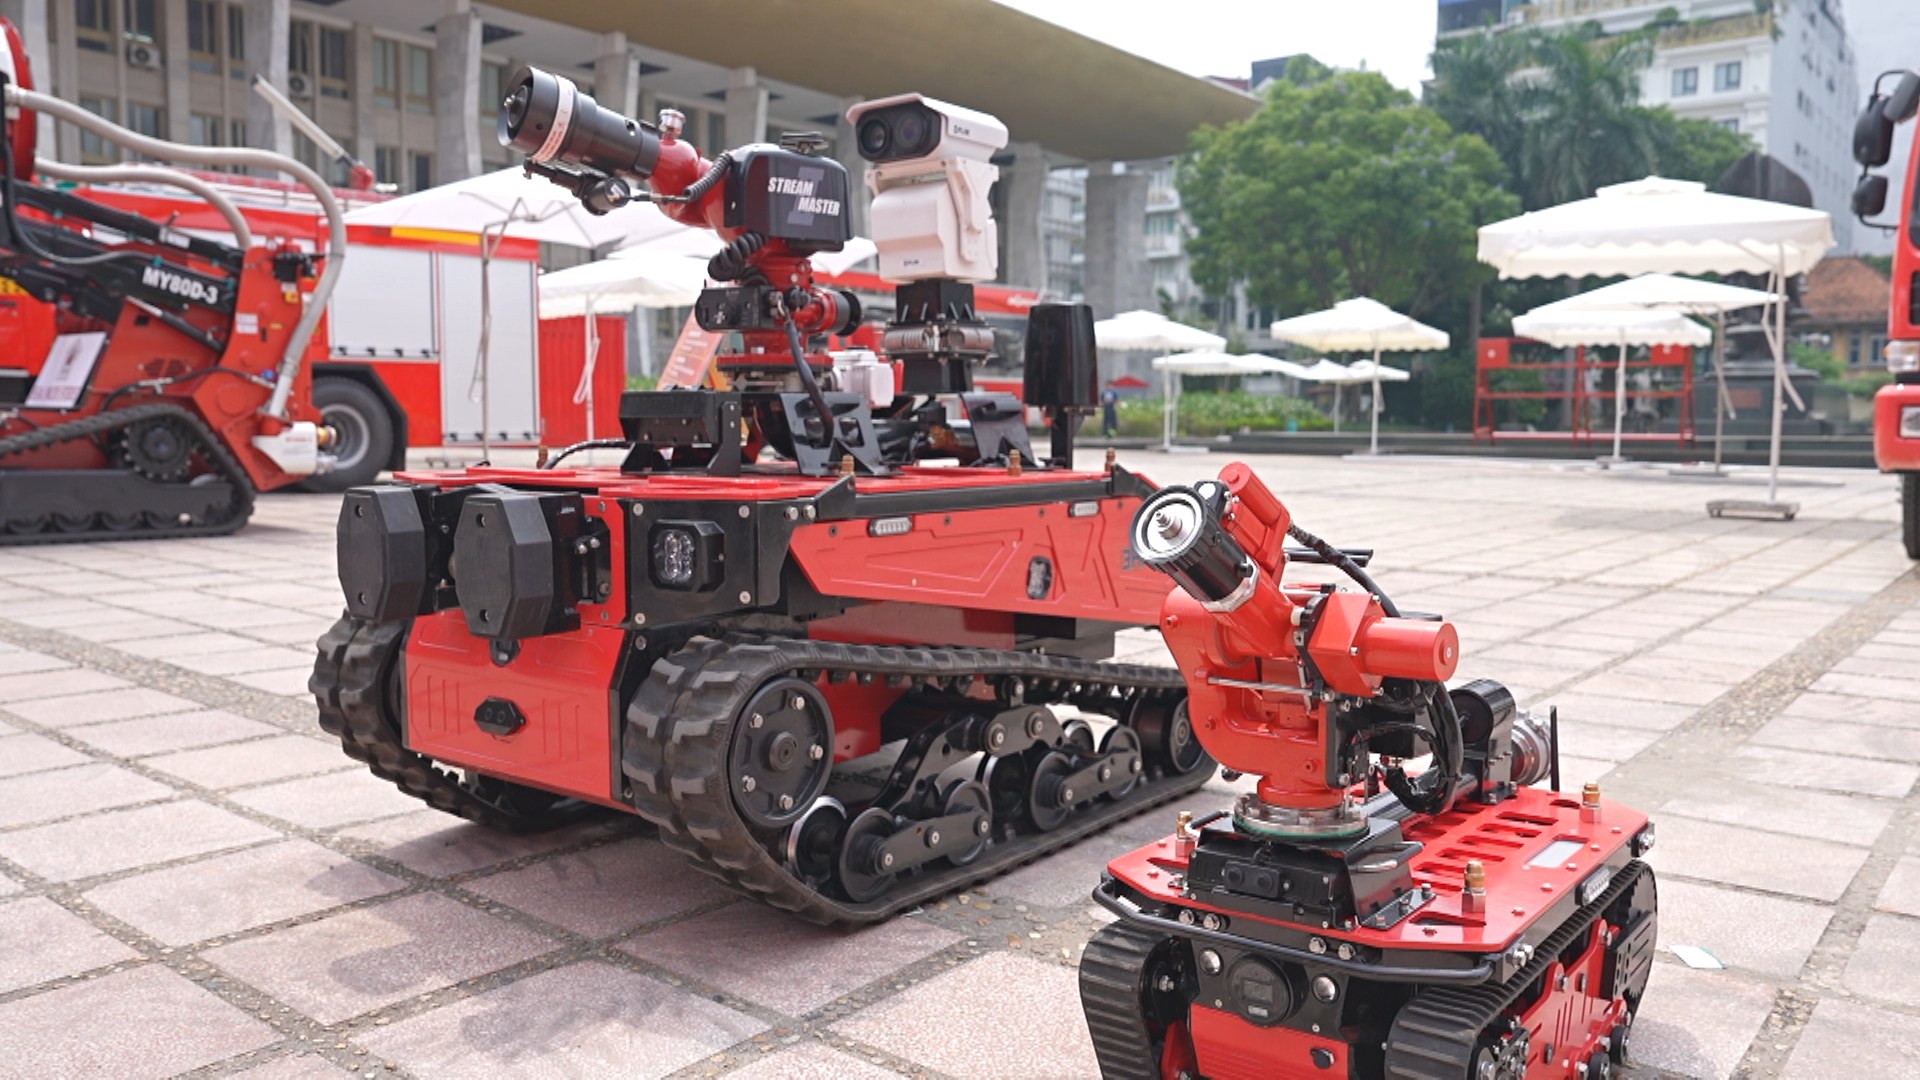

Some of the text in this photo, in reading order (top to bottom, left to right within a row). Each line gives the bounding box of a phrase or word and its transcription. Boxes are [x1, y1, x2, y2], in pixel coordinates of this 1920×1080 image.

[768, 177, 814, 196] STREAM
[798, 197, 840, 216] MASTER
[142, 265, 218, 304] MY80D-3
